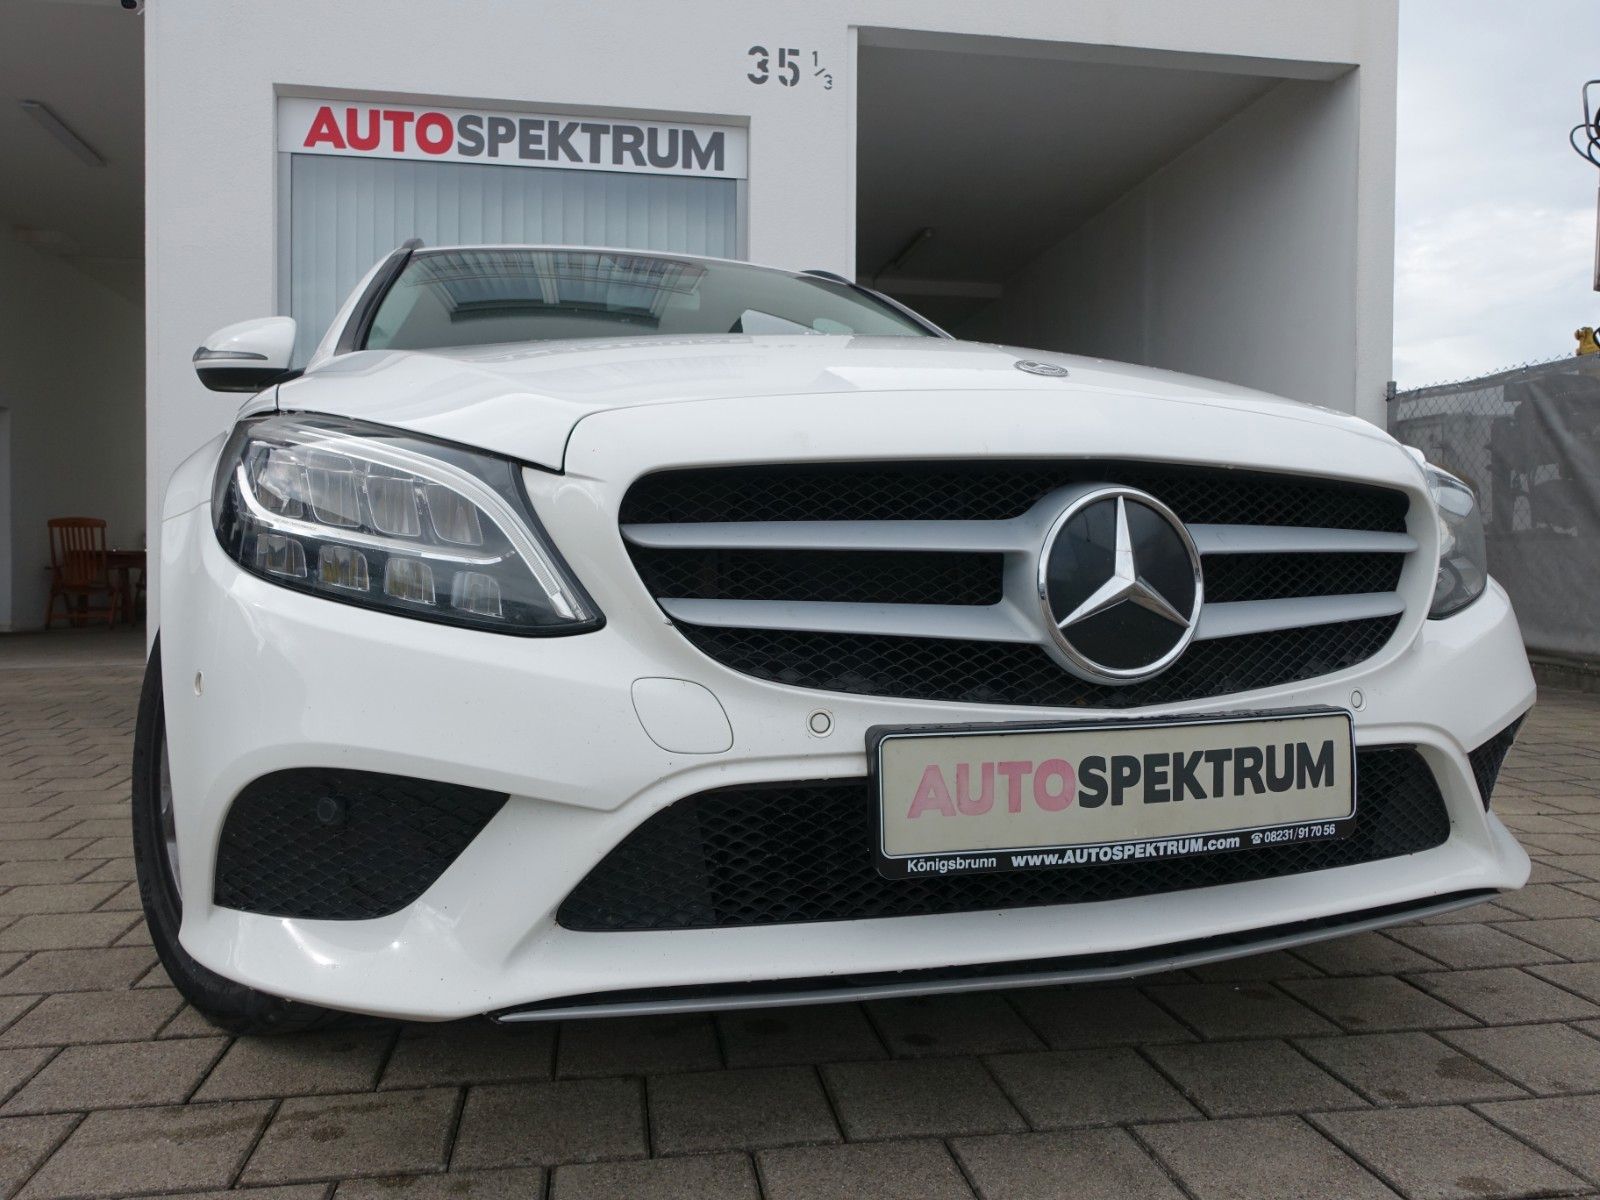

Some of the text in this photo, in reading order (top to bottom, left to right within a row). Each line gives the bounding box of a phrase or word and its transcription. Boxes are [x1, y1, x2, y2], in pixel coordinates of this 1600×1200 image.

[747, 45, 800, 88] 35
[302, 105, 726, 173] AUTOSPEKTRUM
[906, 739, 1335, 819] AUTOSPEKTRUM
[907, 856, 997, 874] Königsbrunn
[1011, 834, 1240, 867] www.AUTOSPEKTRUM.com
